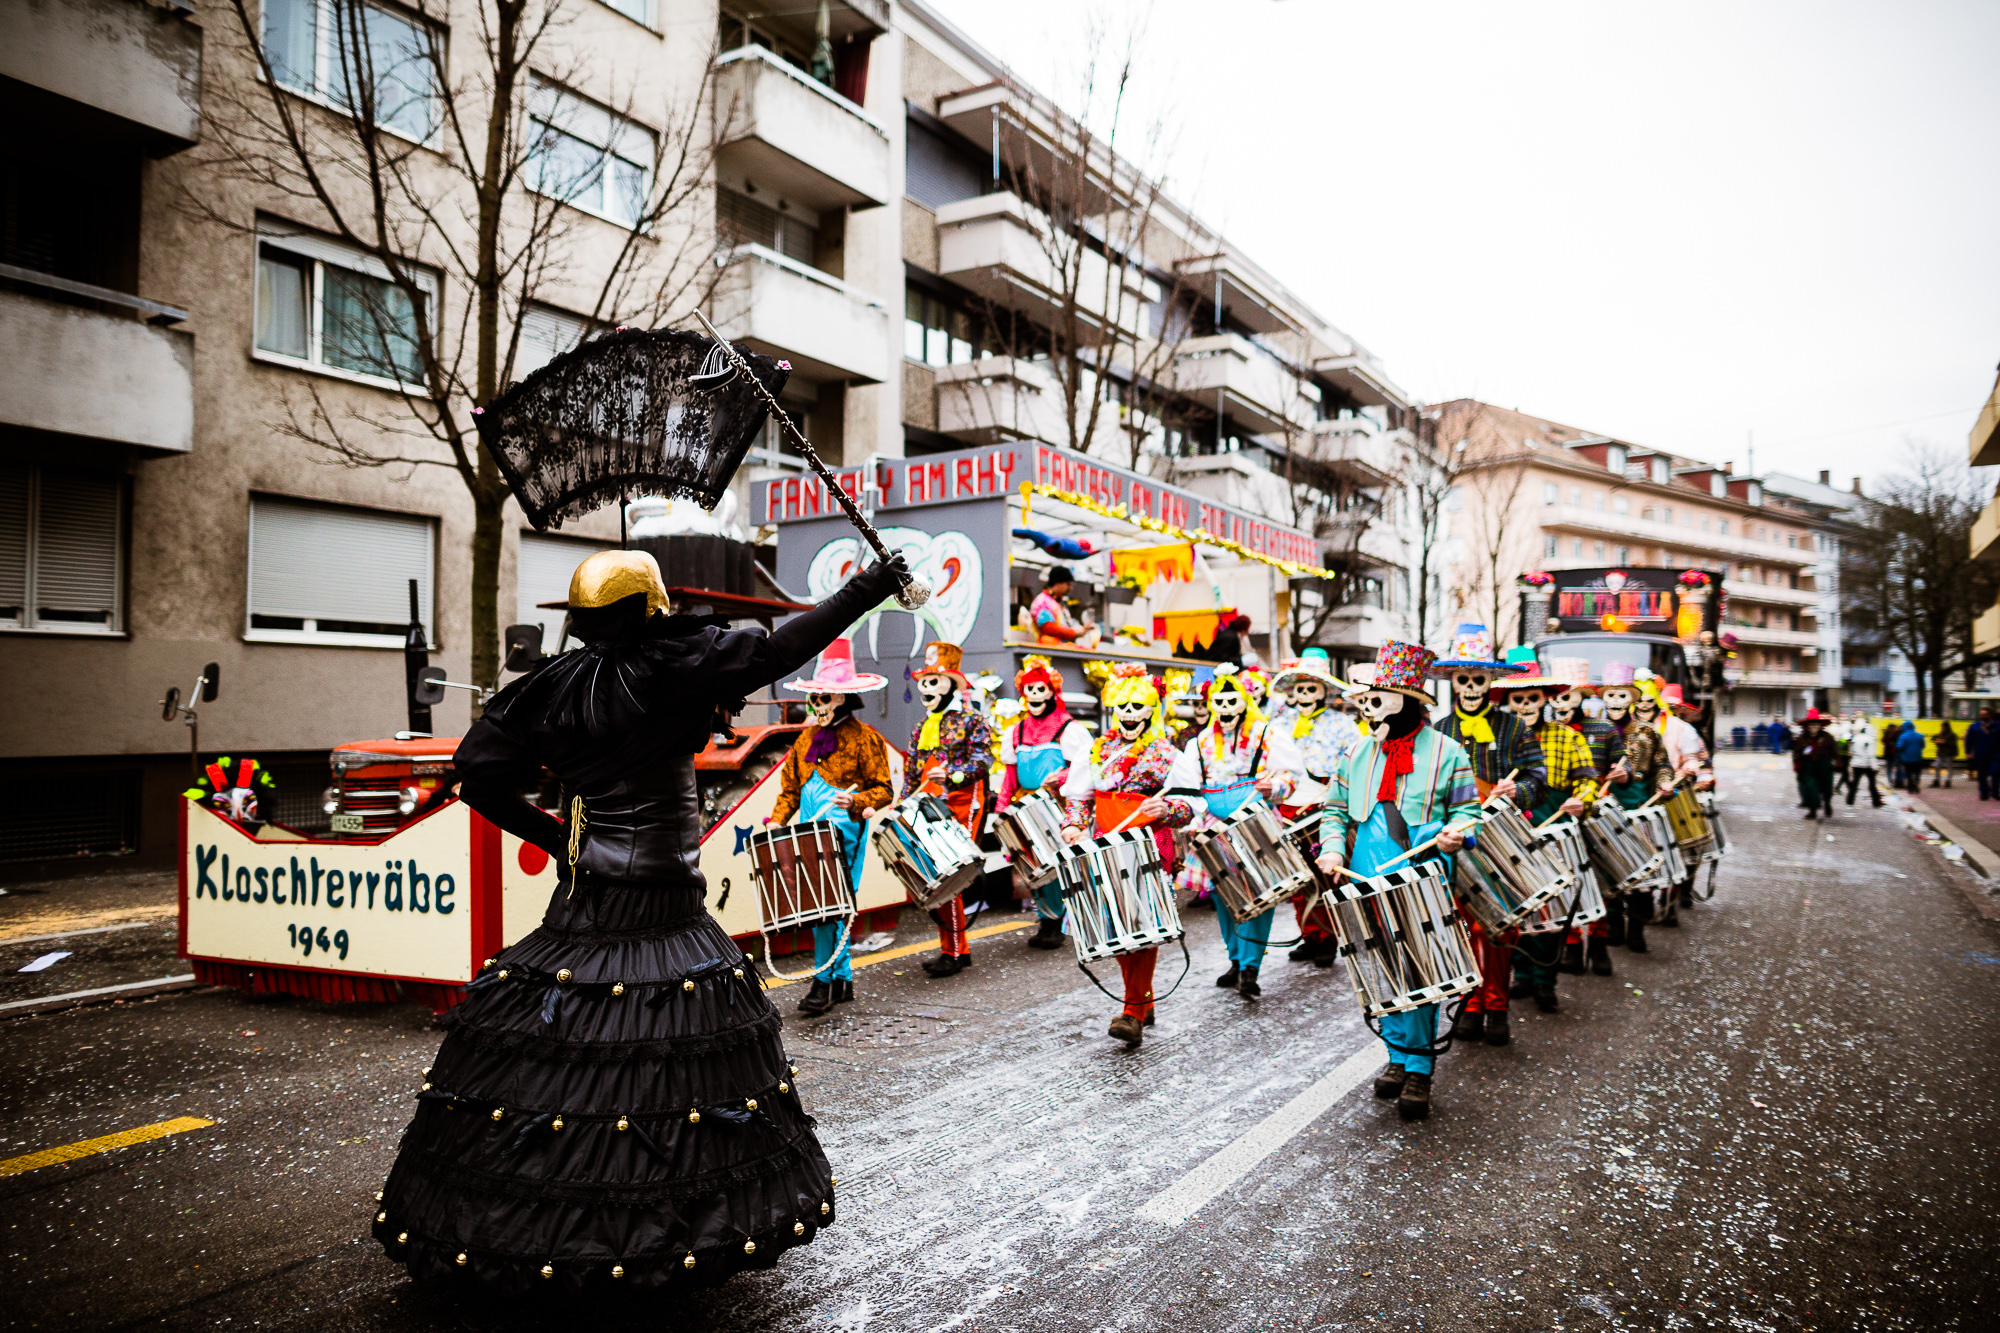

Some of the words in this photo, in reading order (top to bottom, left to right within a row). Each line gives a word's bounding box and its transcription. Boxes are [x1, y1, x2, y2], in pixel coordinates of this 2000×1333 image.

[904, 461, 946, 505] AM
[952, 450, 1015, 499] RHY
[1034, 446, 1122, 507] FANTASY
[1129, 481, 1152, 519] AM
[1157, 490, 1190, 532] RHY
[195, 843, 456, 915] Kloschterräbe
[287, 923, 350, 961] 1949
